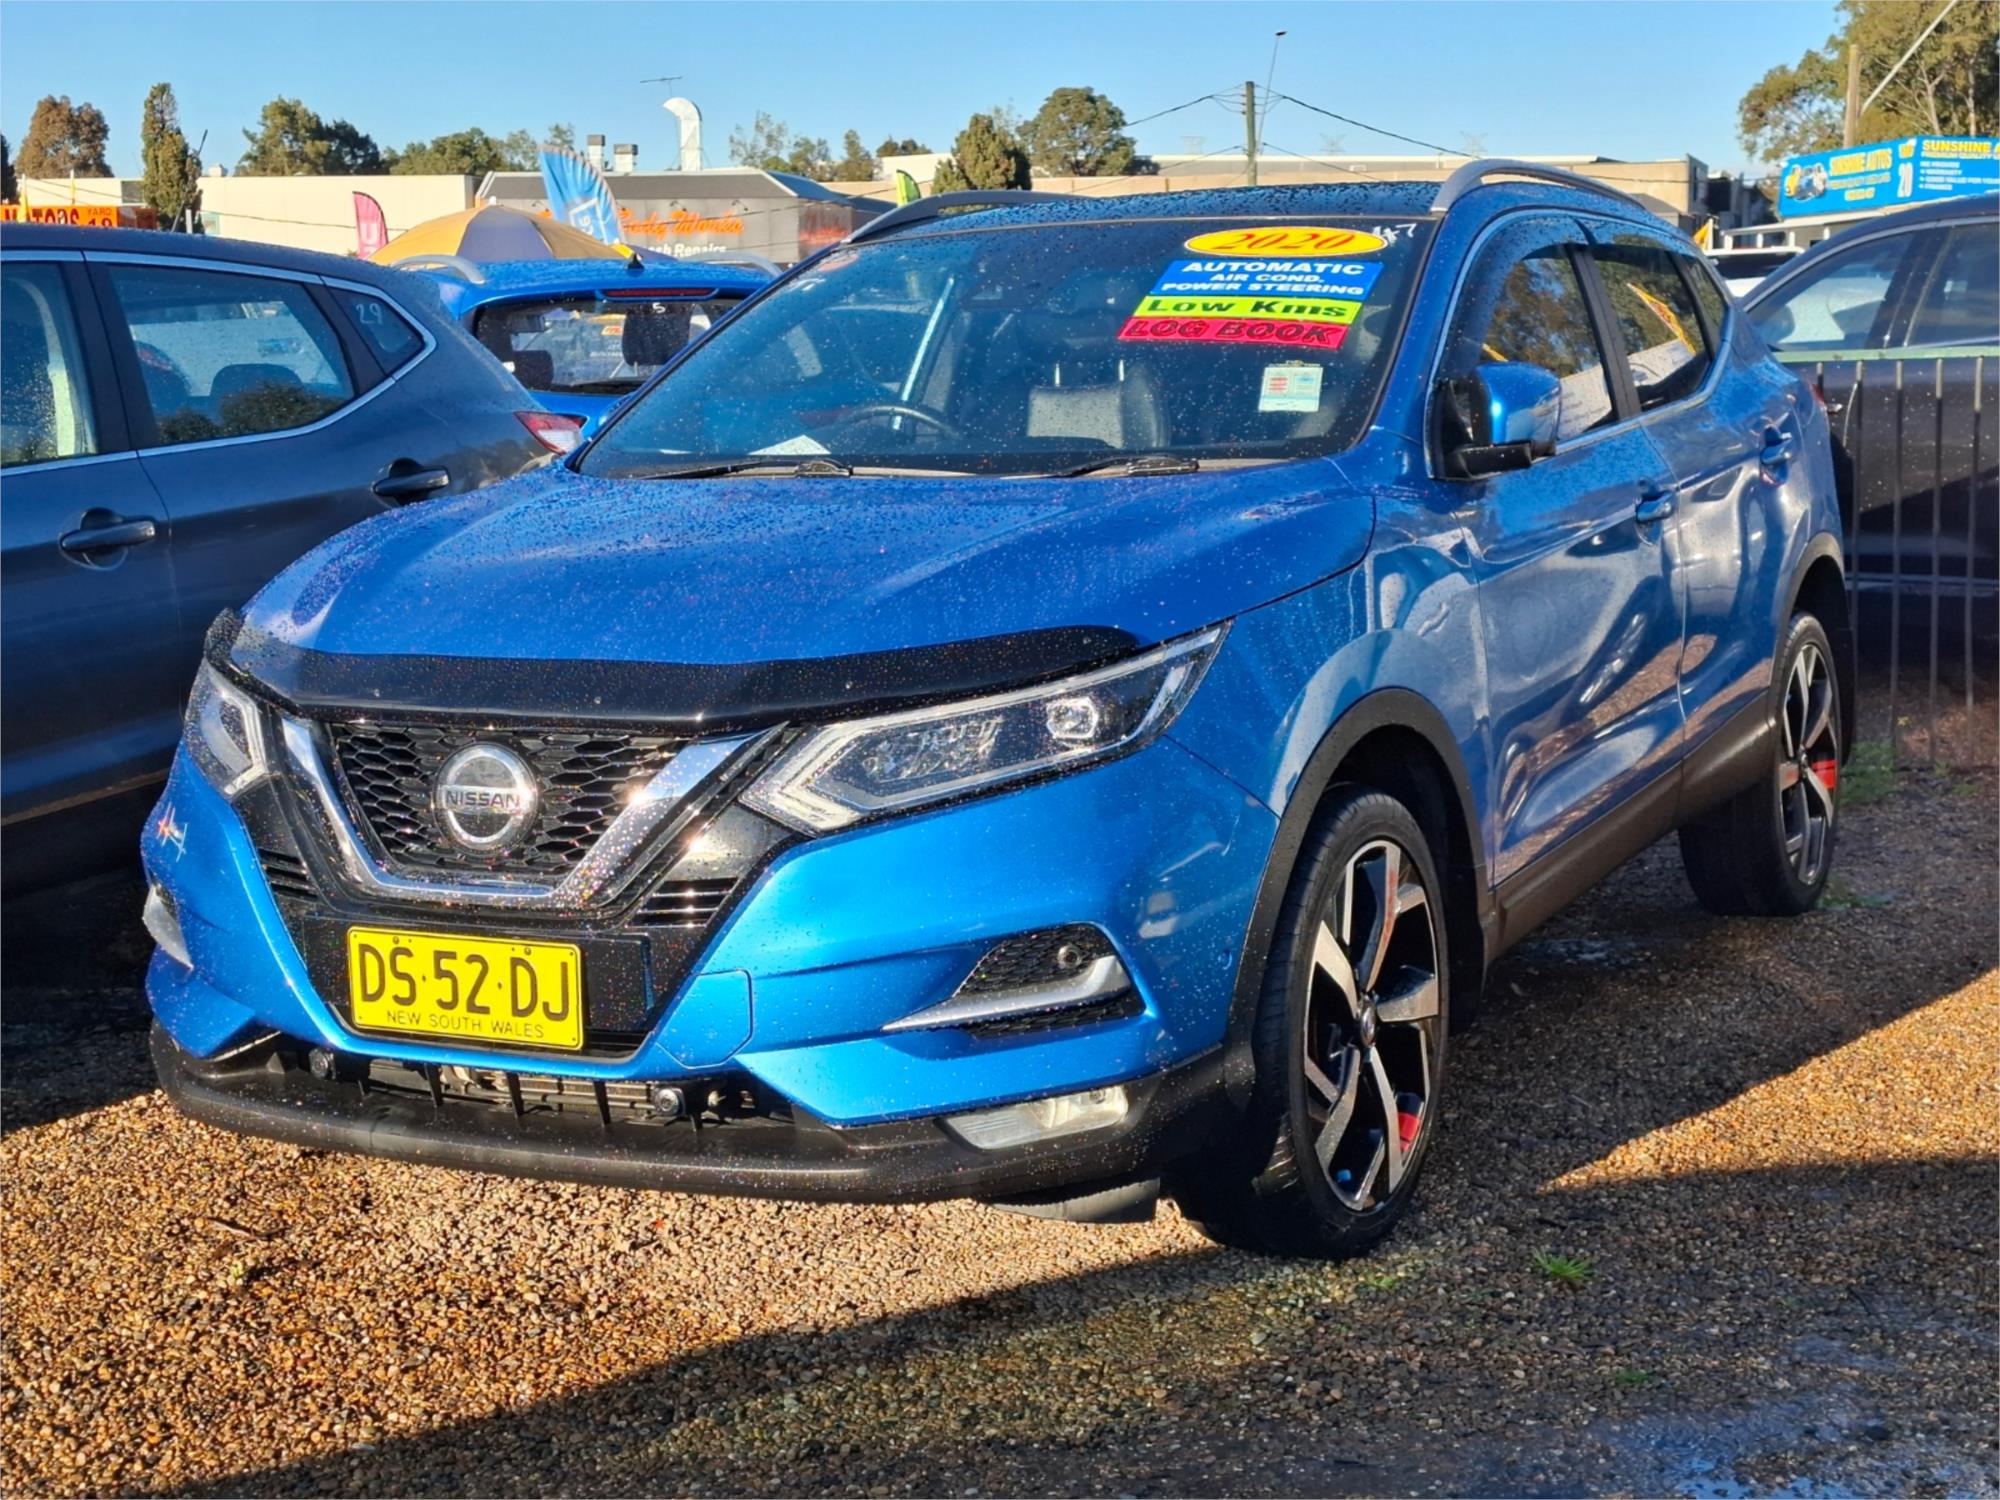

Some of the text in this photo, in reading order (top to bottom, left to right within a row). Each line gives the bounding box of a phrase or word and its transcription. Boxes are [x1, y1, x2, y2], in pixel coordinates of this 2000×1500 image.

[1922, 140, 1992, 153] SUNSHINE
[4, 208, 80, 226] MTORS
[1211, 233, 1356, 250] 2020
[1180, 261, 1366, 275] AUTOMATIC
[1209, 273, 1326, 283] AIR COND.
[1160, 282, 1365, 295] POWER STEERING
[1250, 300, 1348, 318] Kms
[1124, 319, 1342, 345] LOG BOOK
[446, 790, 520, 808] NISSAN
[386, 1010, 544, 1039] NEW SOUTH WALES
